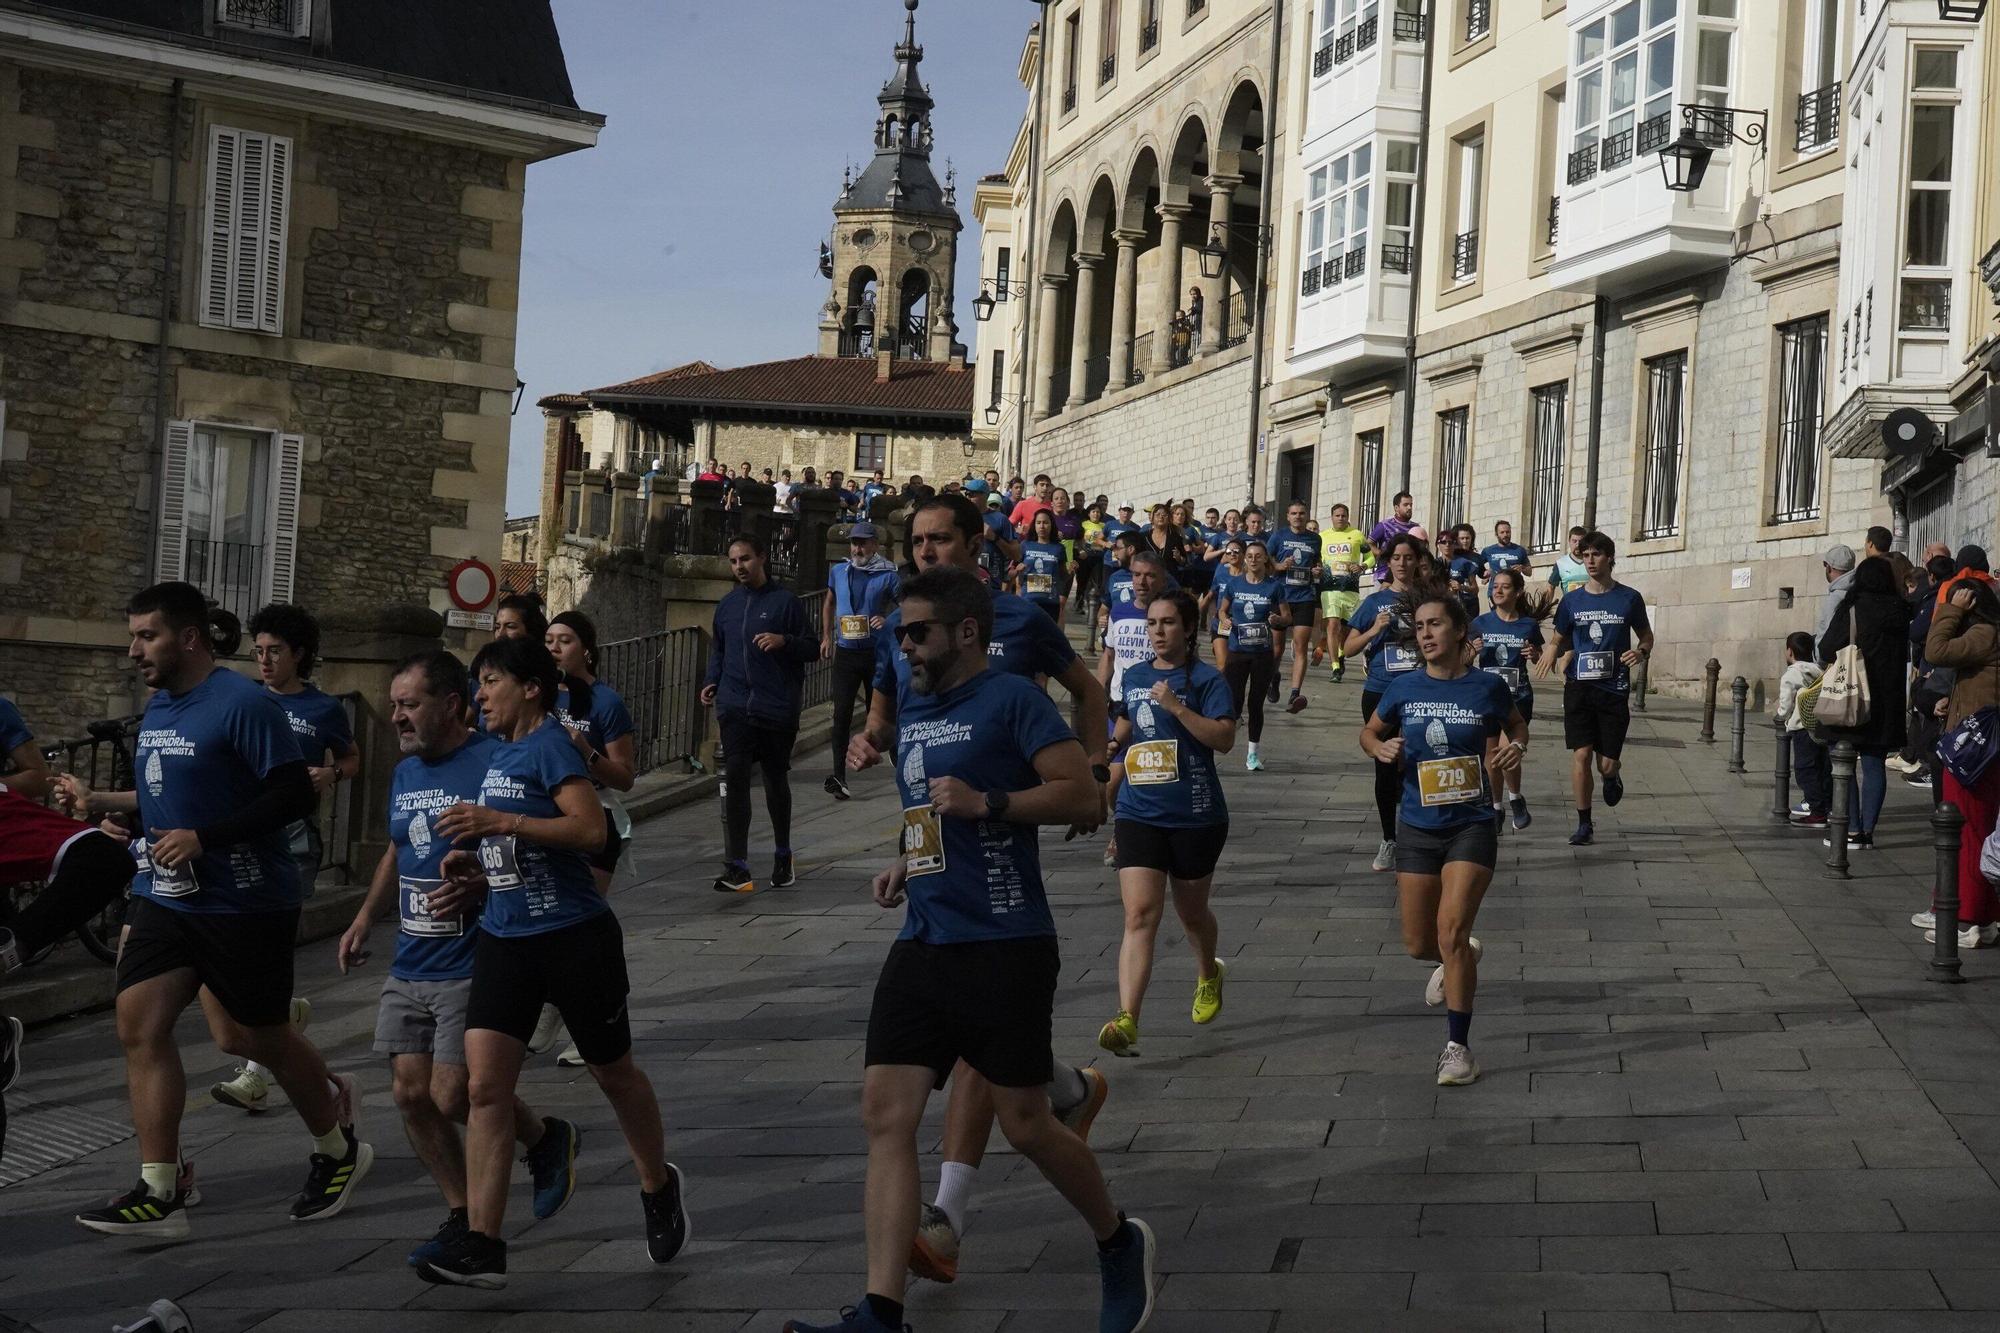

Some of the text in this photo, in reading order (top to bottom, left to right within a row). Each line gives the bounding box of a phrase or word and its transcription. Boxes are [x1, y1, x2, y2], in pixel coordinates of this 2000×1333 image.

[847, 621, 860, 631] 123
[1118, 637, 1144, 647] ALEVIN
[1588, 659, 1604, 669] 914
[1413, 702, 1458, 710] CONQUISTA
[1414, 709, 1474, 717] ALMENDRA
[1446, 717, 1483, 726] KONKISTA
[144, 729, 176, 738] CONQUISTA
[140, 737, 185, 748] ALMENDRA
[926, 731, 971, 747] KONKISTA
[161, 747, 194, 756] KONKISTA
[1137, 751, 1162, 767] 483
[1438, 768, 1465, 787] 279
[402, 788, 444, 801] CONQUISTA
